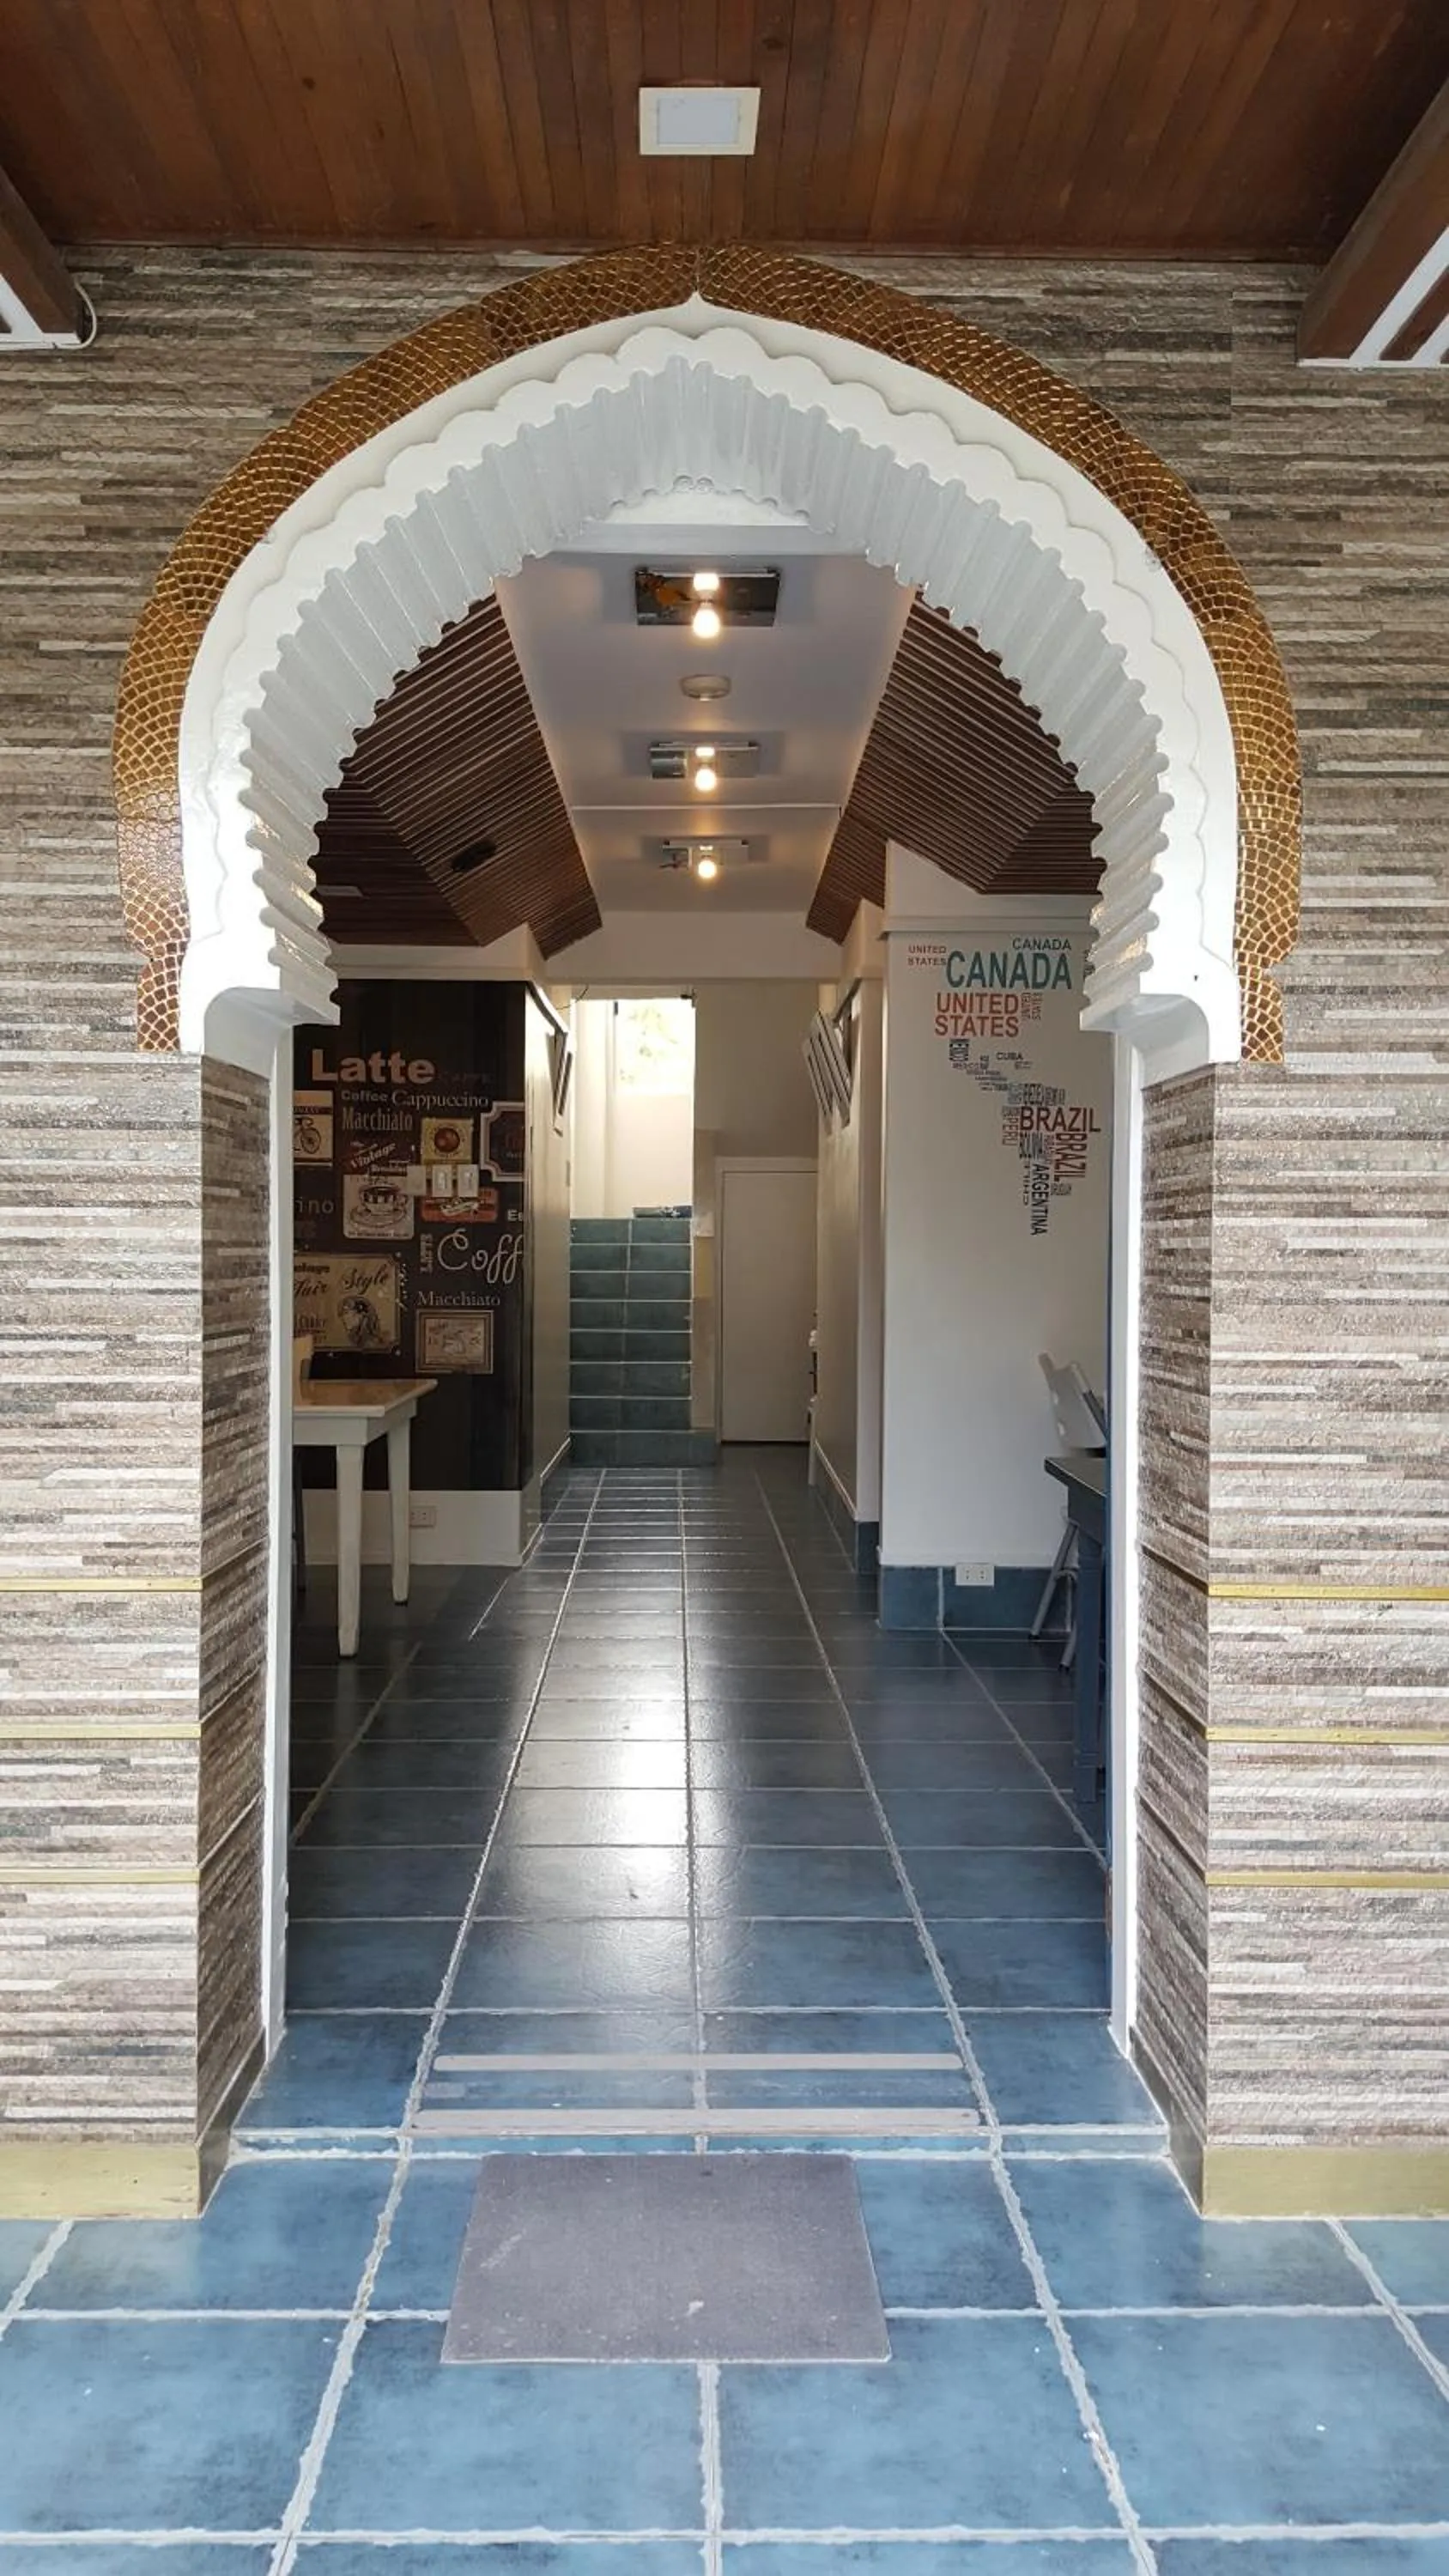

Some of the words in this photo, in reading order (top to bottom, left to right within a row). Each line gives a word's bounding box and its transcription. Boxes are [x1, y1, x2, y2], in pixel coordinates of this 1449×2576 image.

[908, 945, 947, 954] UNITED
[1012, 937, 1072, 951] CANADA
[907, 957, 947, 966] STATES
[946, 951, 1072, 989] CANADA
[937, 993, 1019, 1014] UNITED
[935, 1015, 1020, 1038] STATES
[312, 1048, 436, 1084] Latte
[996, 1052, 1024, 1061] CUBA
[341, 1090, 388, 1103] Coffee
[391, 1089, 489, 1110] Cappuccino
[343, 1106, 413, 1132] Macchiato
[1020, 1106, 1101, 1133] BRAZIL
[1054, 1133, 1088, 1182] BRAZIL
[1031, 1163, 1050, 1236] ARGENTINA
[343, 1263, 389, 1295] Style
[416, 1291, 501, 1307] Macchiato
